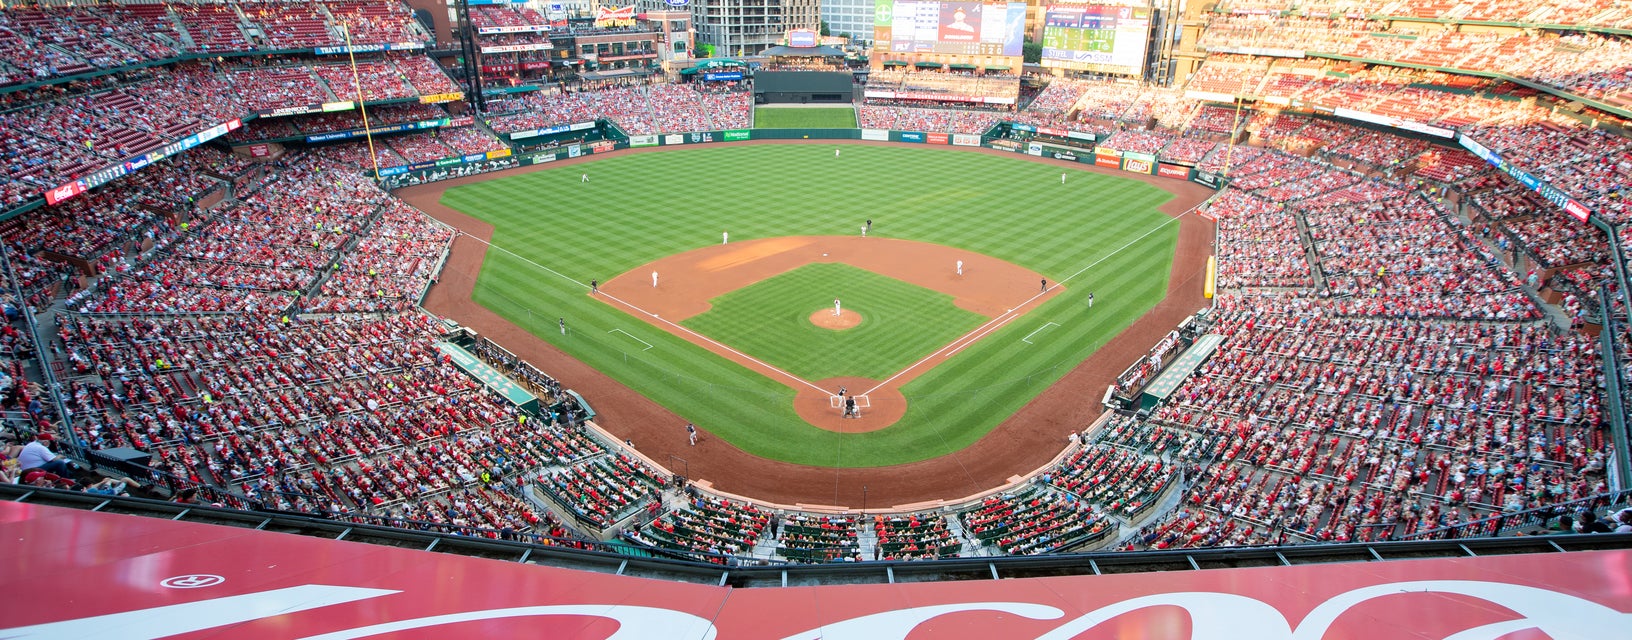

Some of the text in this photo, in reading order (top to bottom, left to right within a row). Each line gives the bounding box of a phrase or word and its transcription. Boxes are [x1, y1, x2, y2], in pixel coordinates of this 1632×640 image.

[600, 10, 634, 20] Budweiser
[1048, 49, 1067, 58] STIFEL
[1094, 54, 1112, 62] SSM
[327, 132, 346, 141] University
